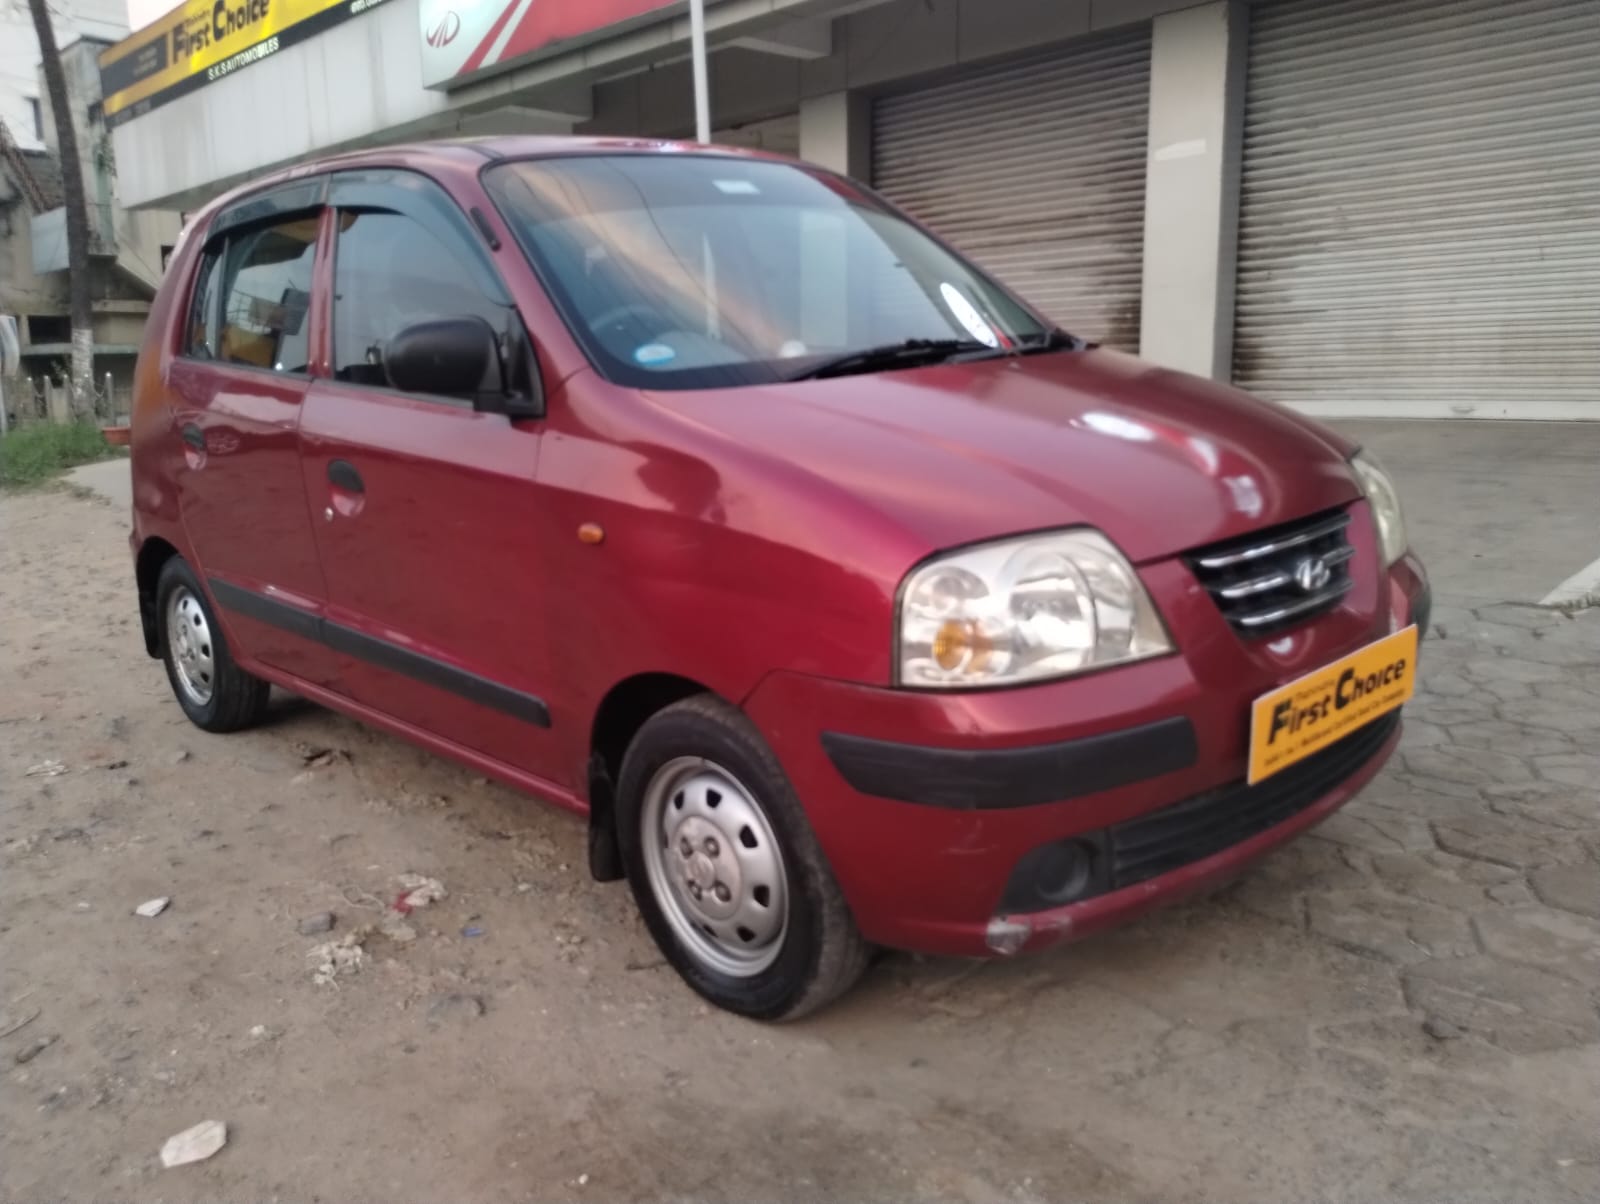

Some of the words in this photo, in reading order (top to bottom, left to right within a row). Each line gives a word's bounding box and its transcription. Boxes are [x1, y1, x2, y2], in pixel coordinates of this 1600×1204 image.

[173, 22, 210, 65] First
[213, 0, 270, 42] Choice
[1266, 695, 1330, 747] First
[1335, 658, 1406, 710] Choice
